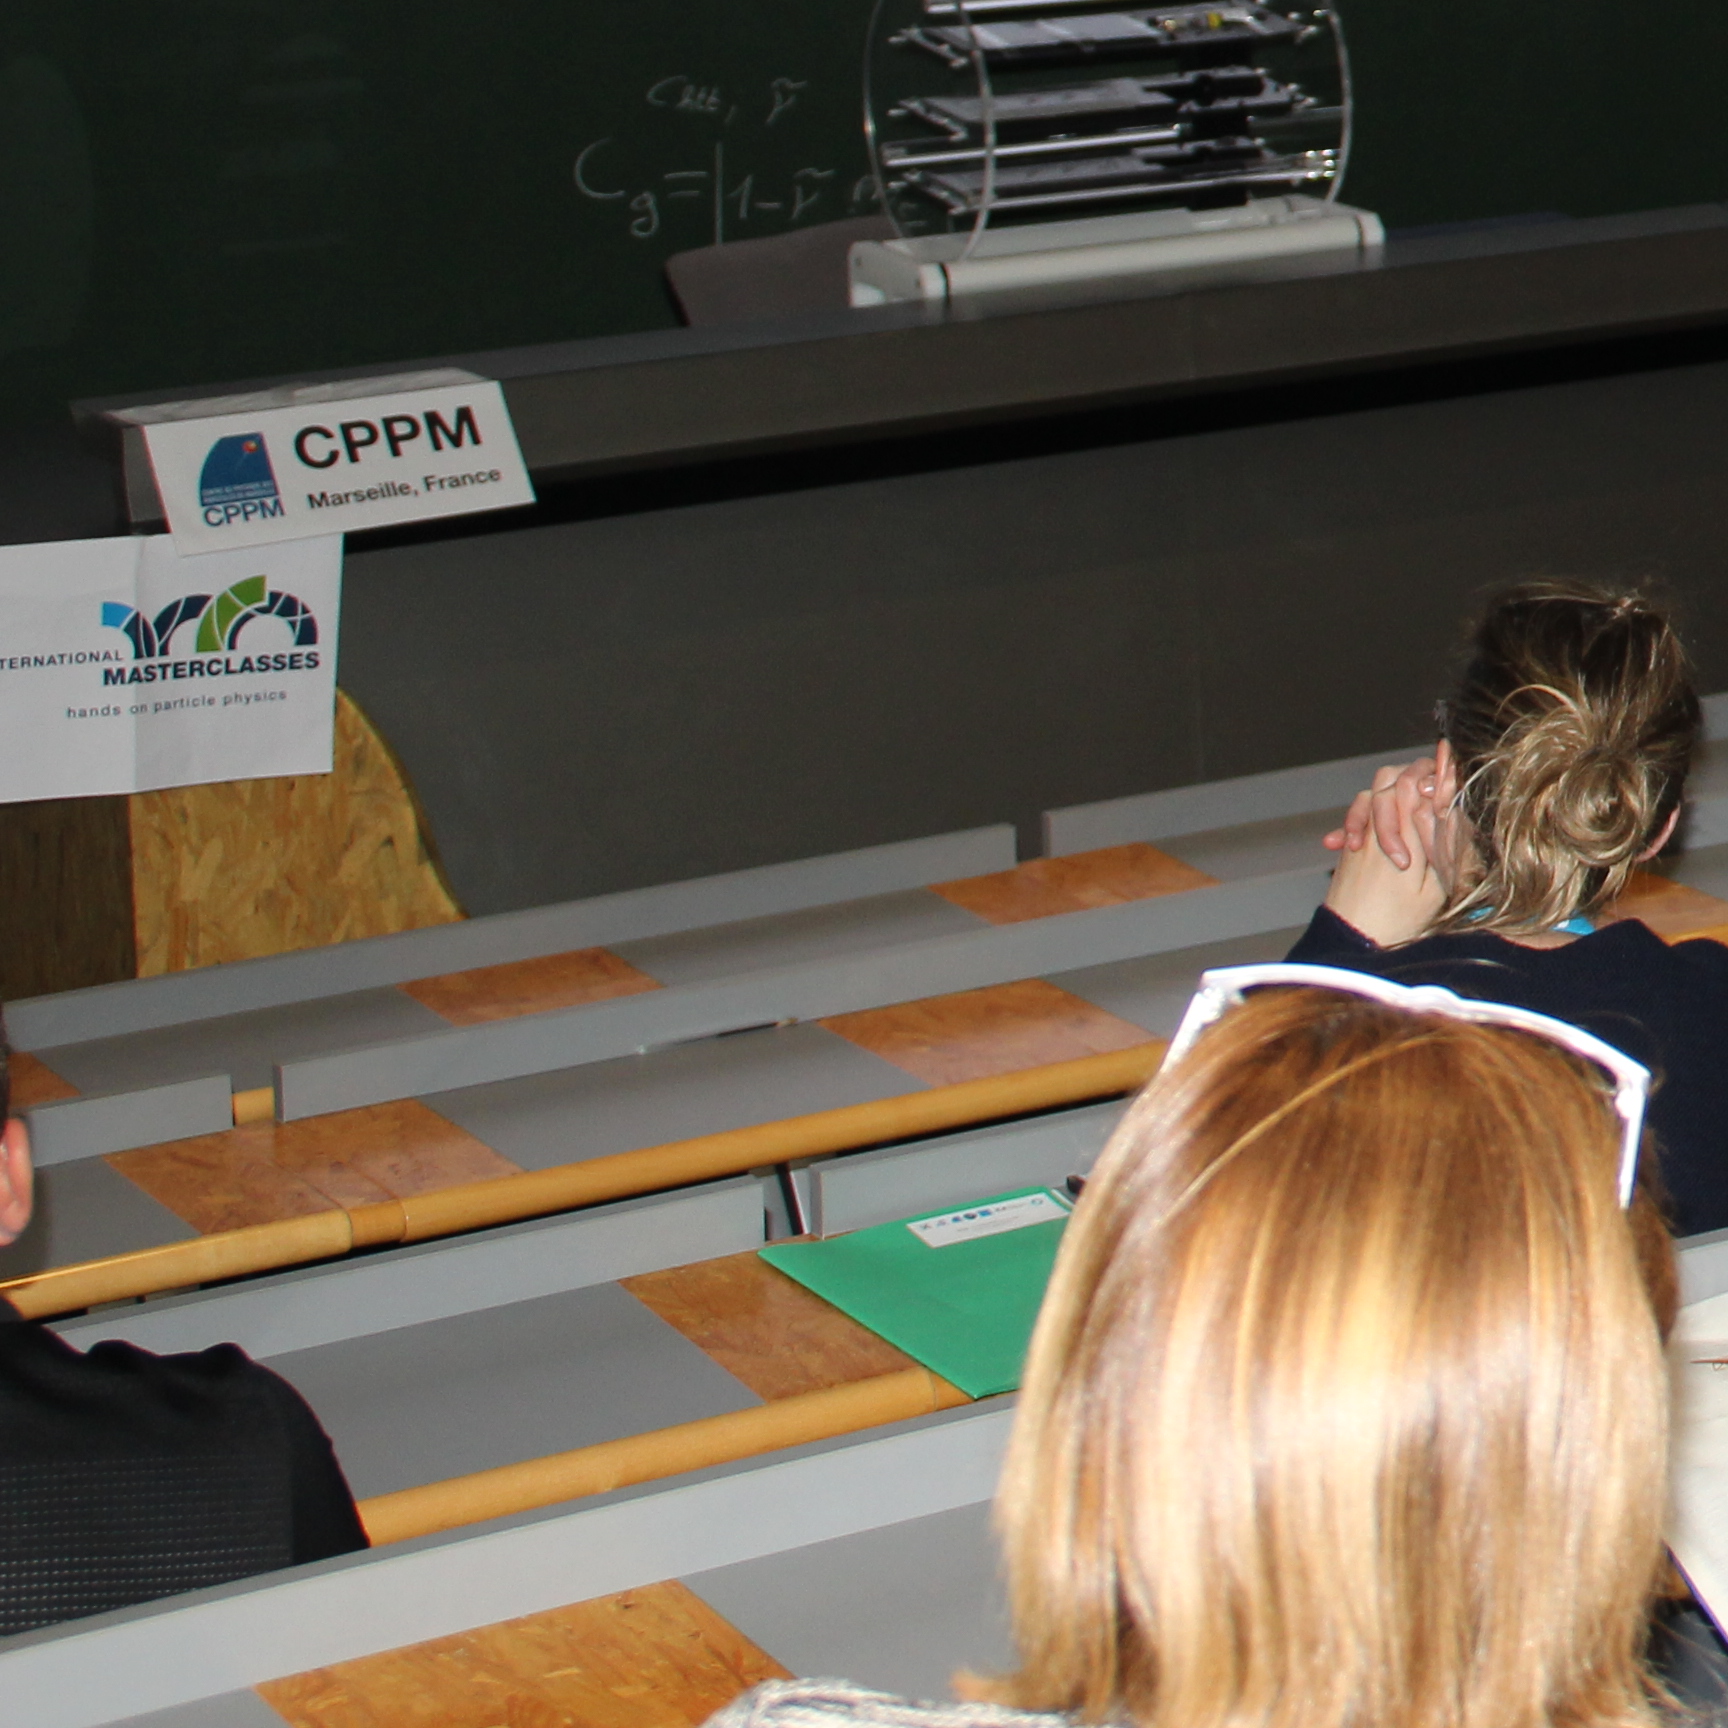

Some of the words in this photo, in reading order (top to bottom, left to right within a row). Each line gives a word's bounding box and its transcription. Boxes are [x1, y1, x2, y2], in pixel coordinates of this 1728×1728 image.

[294, 405, 484, 470] CPPM
[307, 478, 420, 511] Marseille,
[424, 466, 503, 493] France
[203, 497, 286, 528] CPPM
[103, 651, 321, 687] MASTERCLASSES
[66, 705, 121, 720] hands
[129, 701, 149, 715] on
[153, 693, 217, 714] particle
[222, 688, 287, 708] physics
